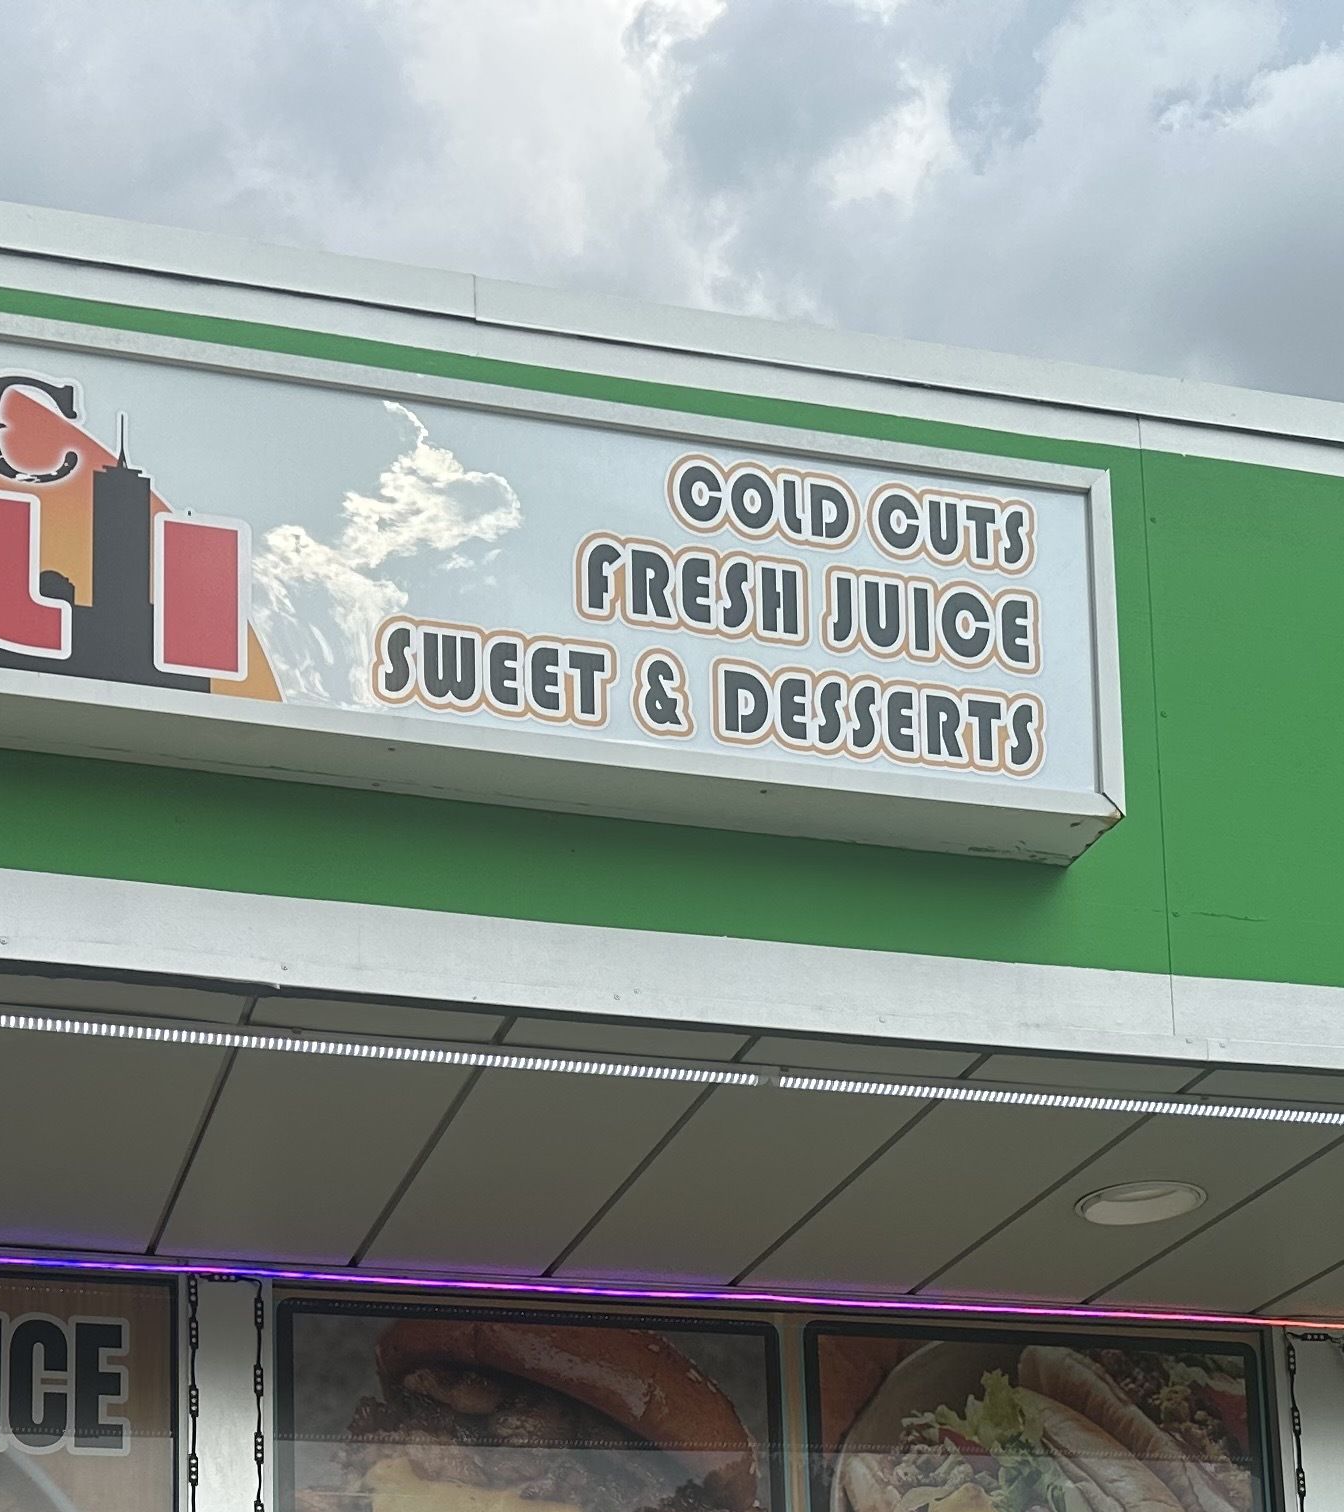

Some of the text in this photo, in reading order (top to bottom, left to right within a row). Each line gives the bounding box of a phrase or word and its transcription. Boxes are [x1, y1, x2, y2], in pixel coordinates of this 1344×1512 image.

[678, 465, 1027, 566] COLD CUTS
[585, 543, 1030, 666] FRESH JUICE
[383, 624, 1036, 768] SWEET & DESSERTS
